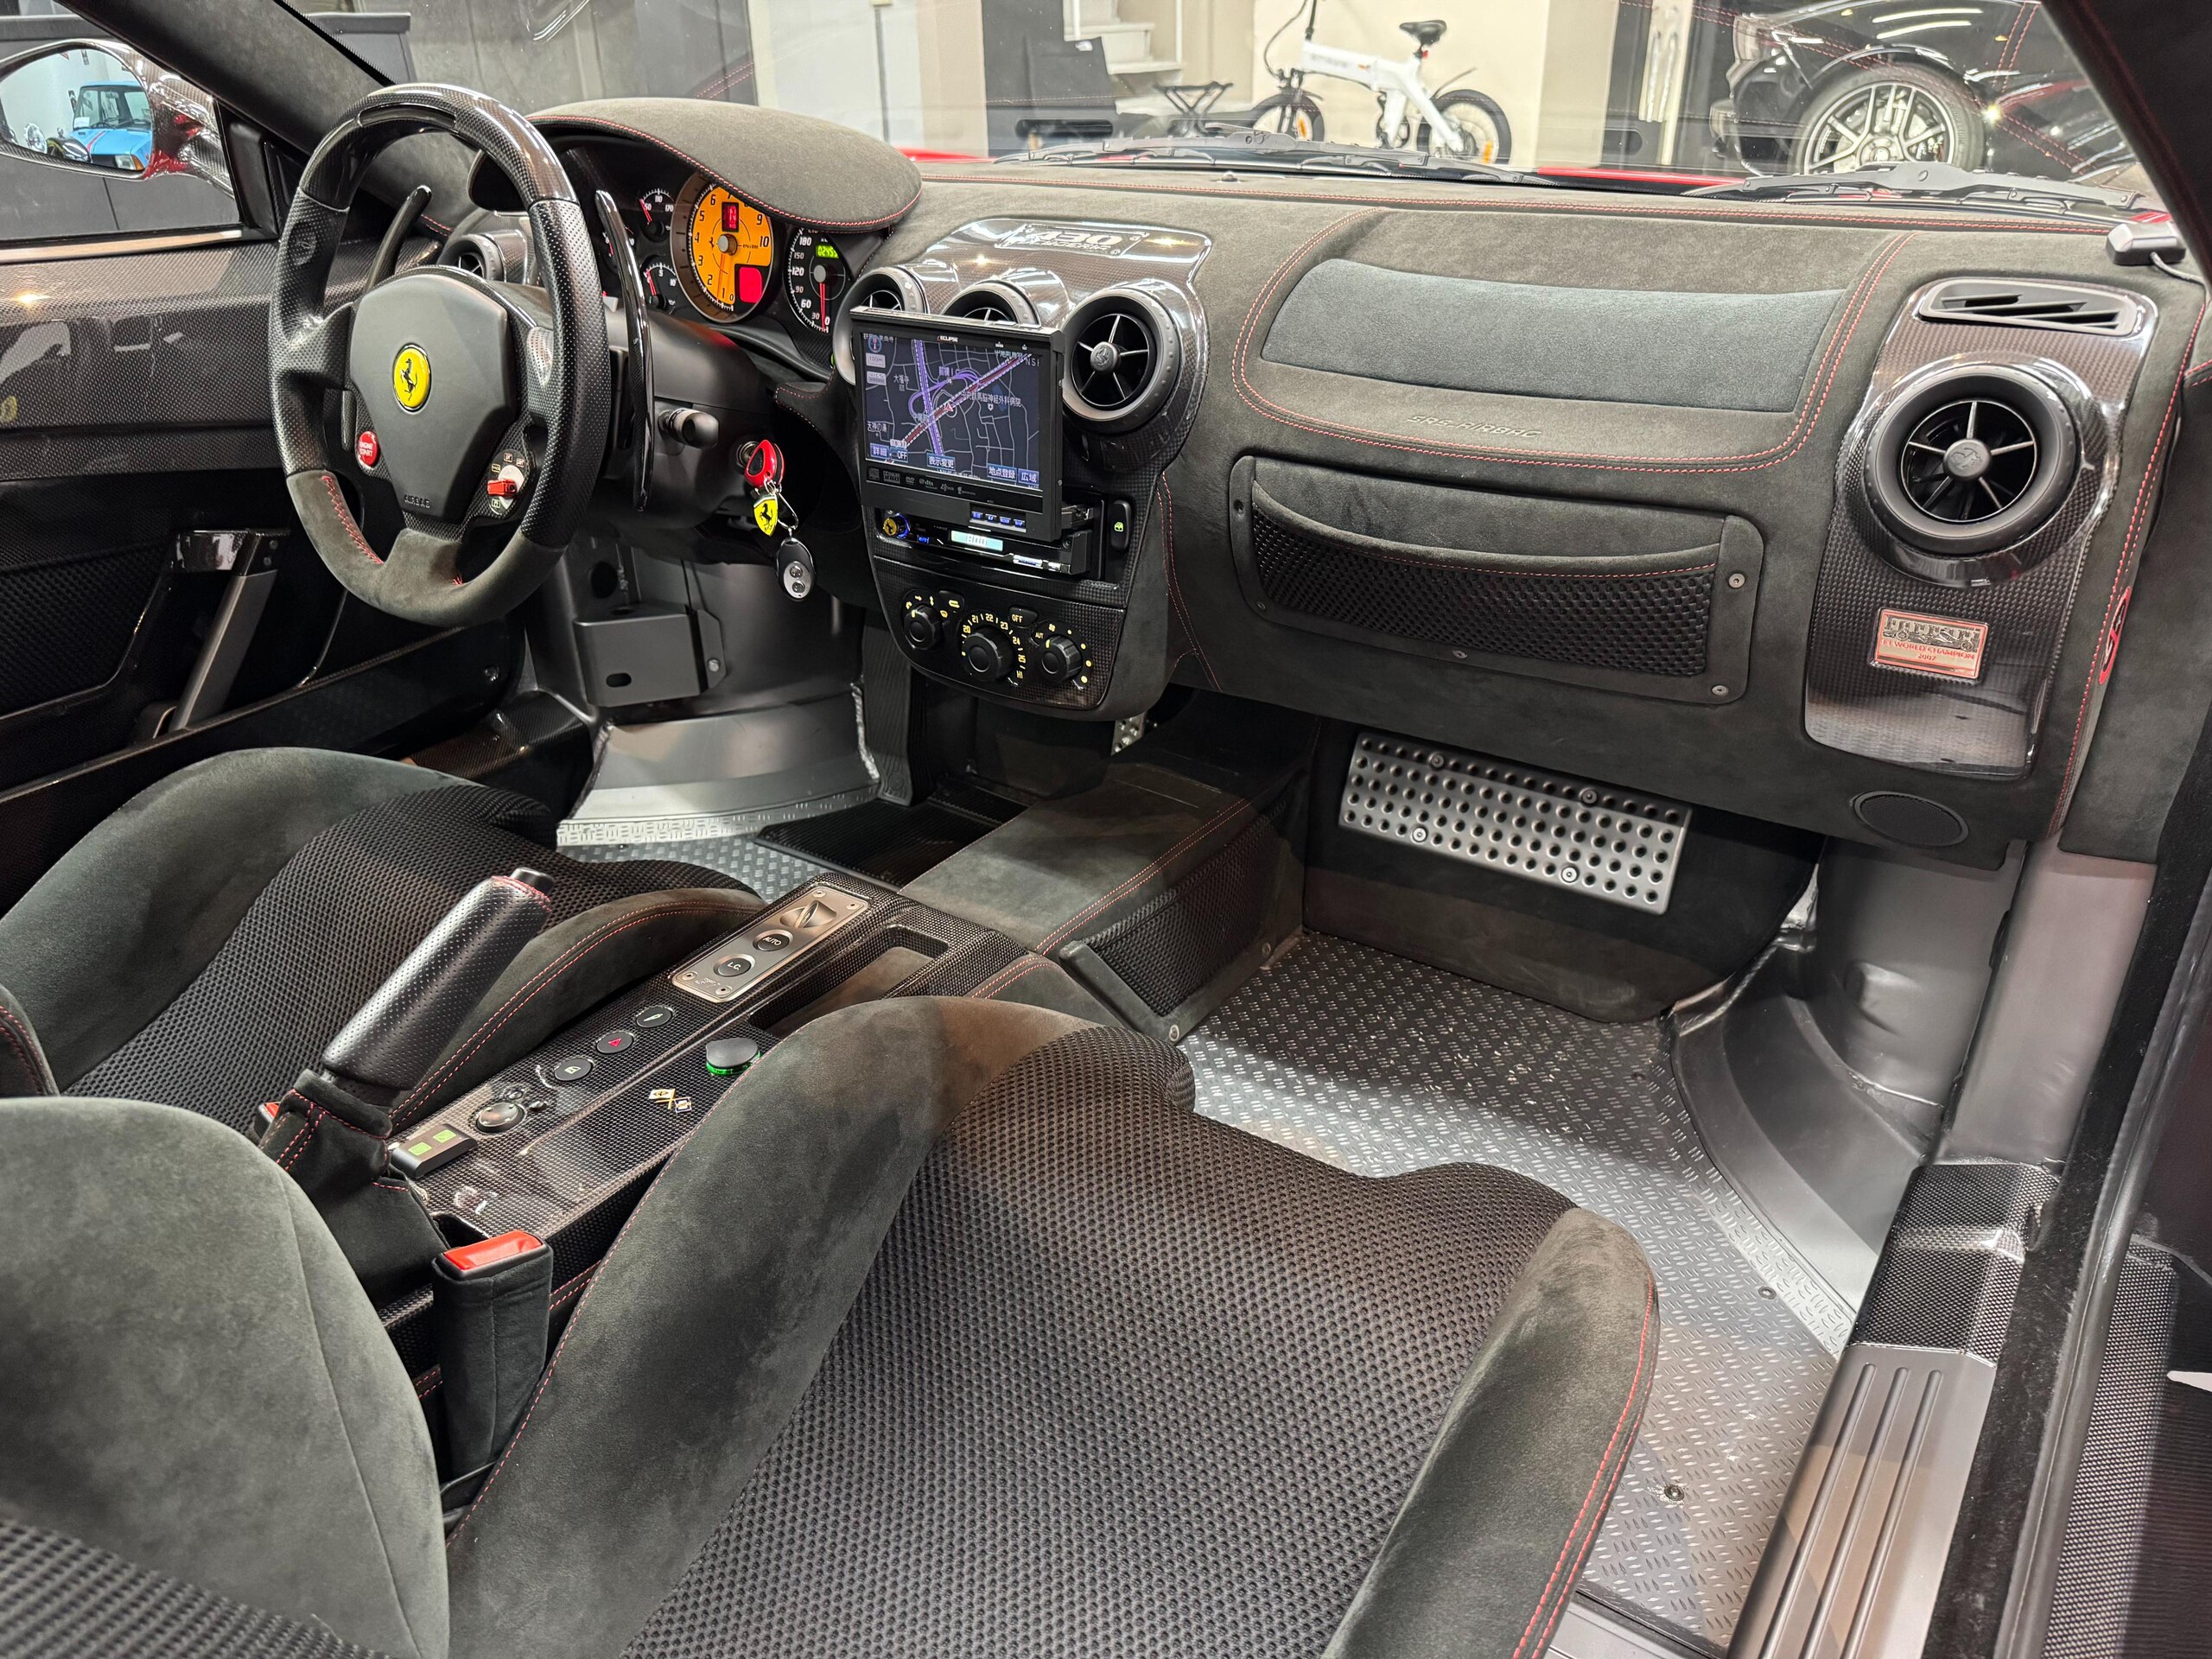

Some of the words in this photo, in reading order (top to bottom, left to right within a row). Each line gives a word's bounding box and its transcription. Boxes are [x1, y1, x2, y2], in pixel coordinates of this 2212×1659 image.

[710, 194, 716, 206] 6
[699, 210, 705, 221] 5
[756, 214, 762, 226] 9
[694, 232, 700, 243] 4
[760, 236, 770, 247] 10
[799, 237, 812, 246] 180
[698, 256, 703, 266] 3
[791, 267, 804, 276] 120
[707, 275, 713, 285] 2
[801, 299, 811, 308] 60
[824, 316, 830, 325] 0
[897, 450, 907, 460] OFF
[928, 456, 955, 470] 表示変更
[988, 467, 1015, 480] 地点登録
[1020, 472, 1038, 484] 広域
[971, 615, 979, 624] 21
[985, 613, 994, 622] 22
[1012, 614, 1023, 623] OFF
[963, 625, 971, 633] 20
[1000, 621, 1008, 631] 23
[1013, 637, 1020, 645] 24
[1894, 641, 1927, 652] WORLD
[1927, 646, 1975, 660] CHAMPION
[1018, 655, 1026, 664] 25
[1016, 671, 1023, 679] HI
[763, 937, 781, 945] AUTO
